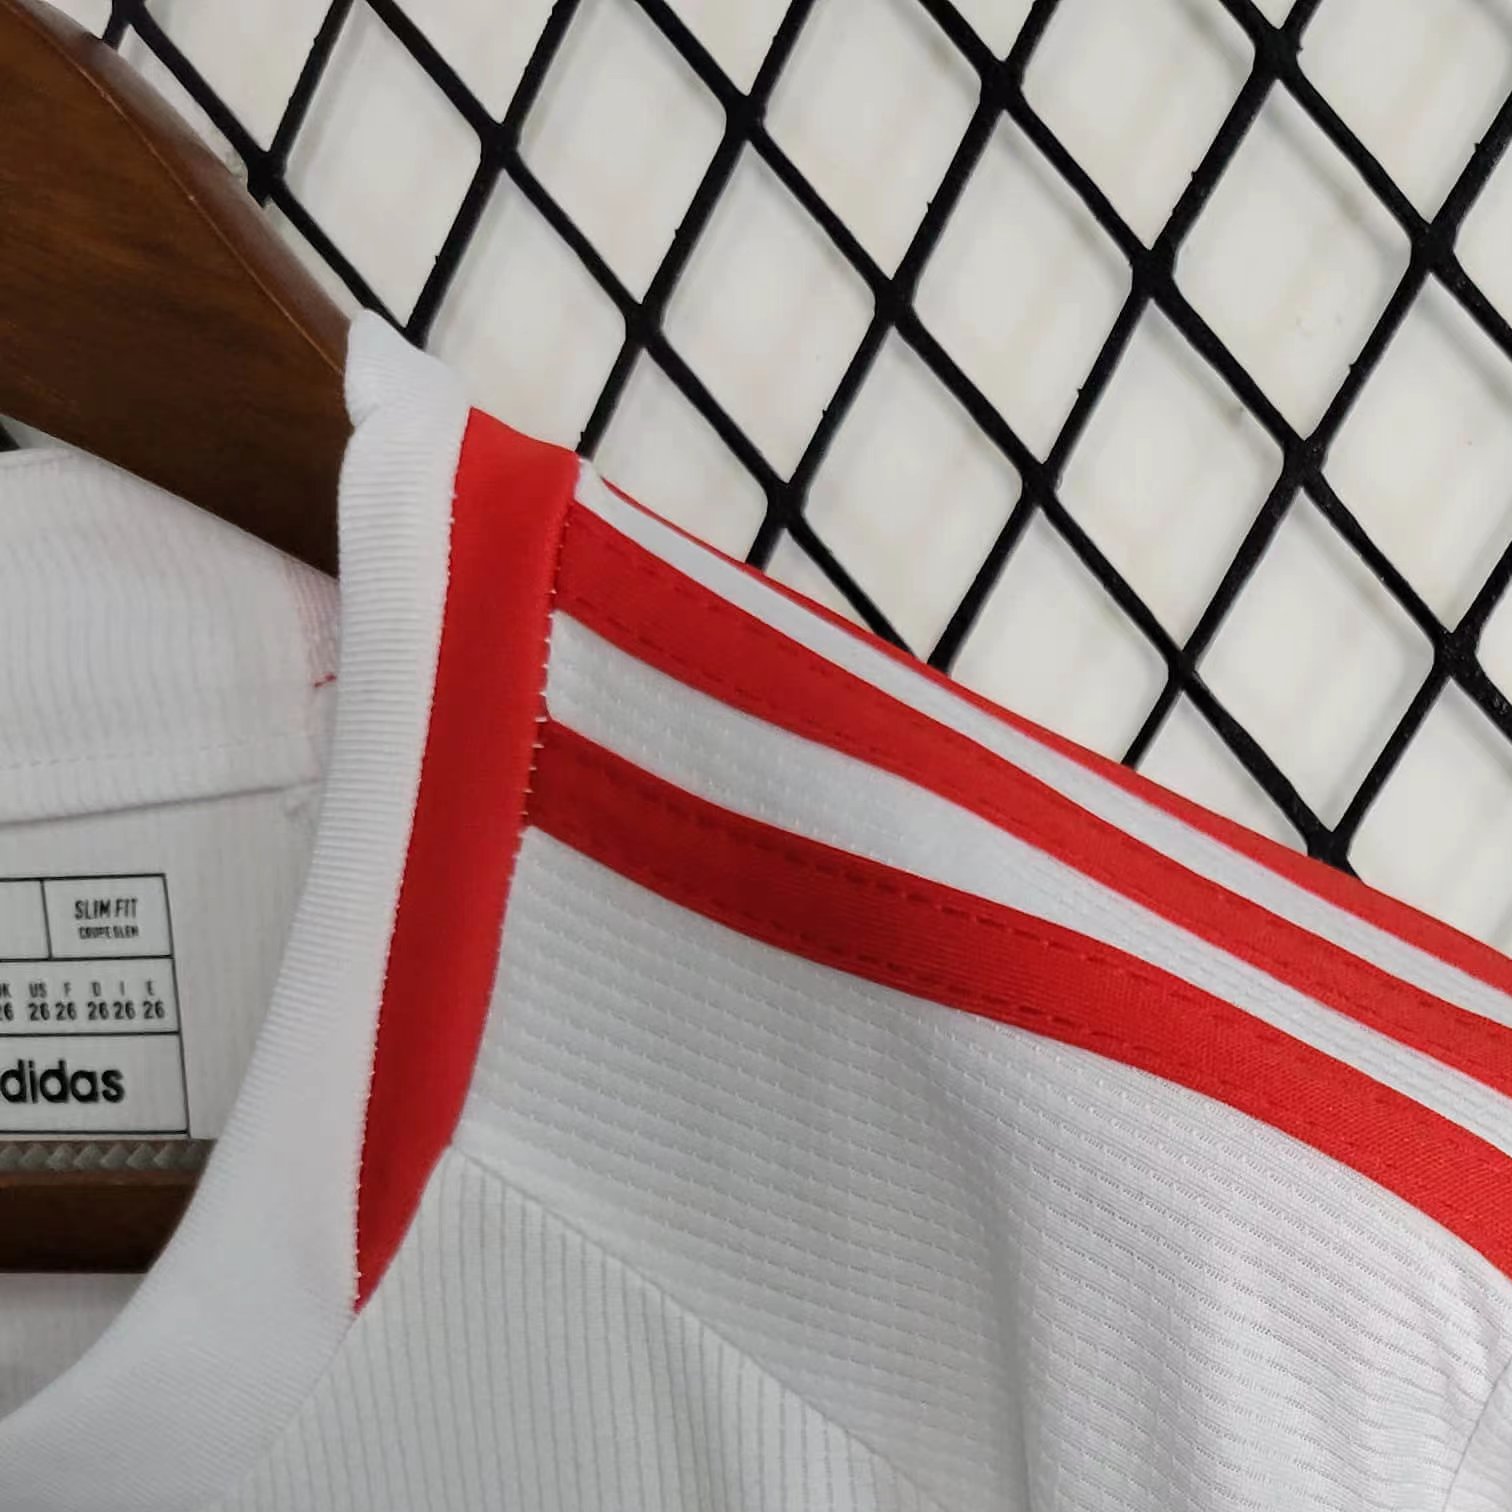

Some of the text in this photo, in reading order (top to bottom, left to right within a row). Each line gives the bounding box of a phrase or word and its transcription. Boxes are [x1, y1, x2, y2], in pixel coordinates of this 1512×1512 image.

[75, 897, 138, 920] SLIM FIT
[28, 981, 47, 998] US
[63, 981, 72, 997] F
[28, 1001, 50, 1021] 26
[55, 1001, 77, 1021] 26
[87, 1001, 109, 1020] 26
[112, 1001, 136, 1020] 26
[143, 1000, 165, 1020] 26
[0, 1059, 125, 1104] didas
